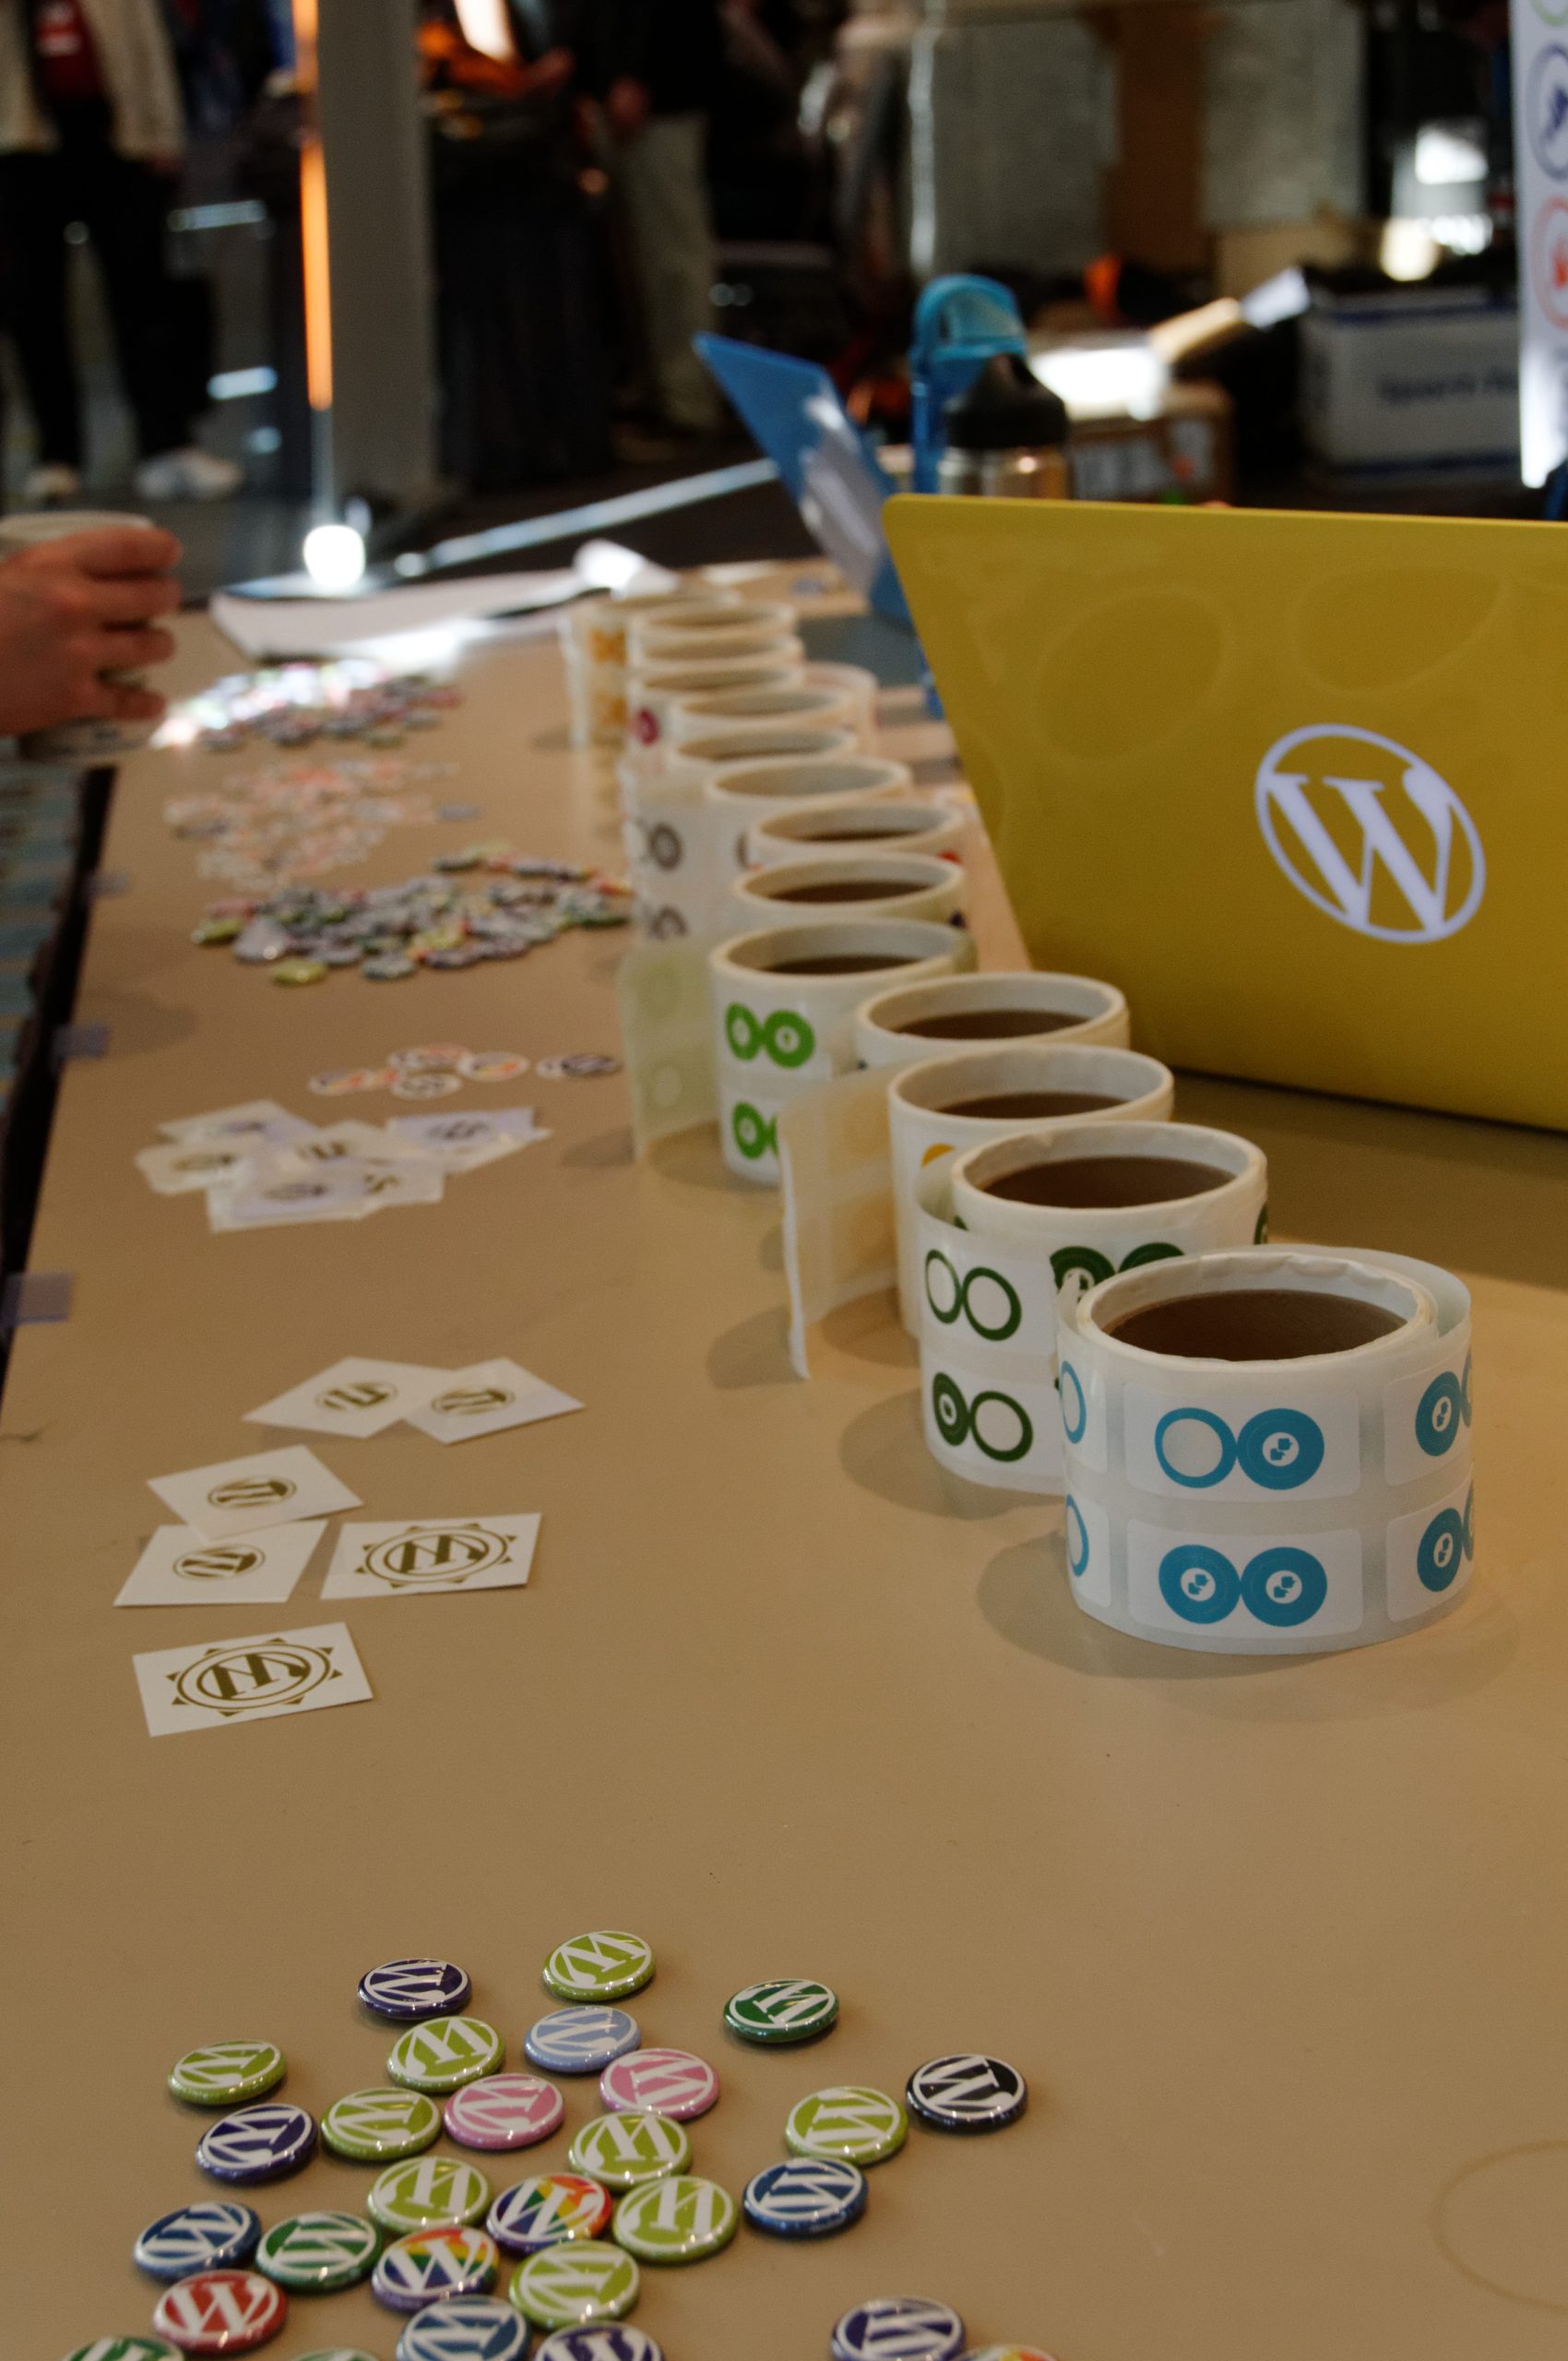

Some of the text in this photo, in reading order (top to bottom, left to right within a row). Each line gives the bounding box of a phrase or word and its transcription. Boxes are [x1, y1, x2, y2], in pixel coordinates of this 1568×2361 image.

[1258, 764, 1457, 935] W
[366, 1961, 448, 2003] W
[557, 1933, 649, 1987] W
[735, 1980, 834, 2025] W
[398, 2017, 493, 2077] W
[531, 2008, 619, 2055] W
[173, 2042, 273, 2087] W
[619, 2052, 712, 2109] W
[917, 2056, 1016, 2114] W
[330, 2090, 422, 2142] W
[455, 2078, 549, 2130] W
[804, 2088, 899, 2147] W
[203, 2106, 303, 2163] W
[580, 2114, 683, 2170] W
[373, 2158, 477, 2216] W
[501, 2177, 601, 2237] W
[619, 2178, 726, 2239] W
[754, 2159, 860, 2213] W
[140, 2204, 246, 2260] W
[267, 2213, 375, 2268] W
[384, 2231, 487, 2292] W
[522, 2244, 625, 2314] W
[163, 2276, 270, 2339] W
